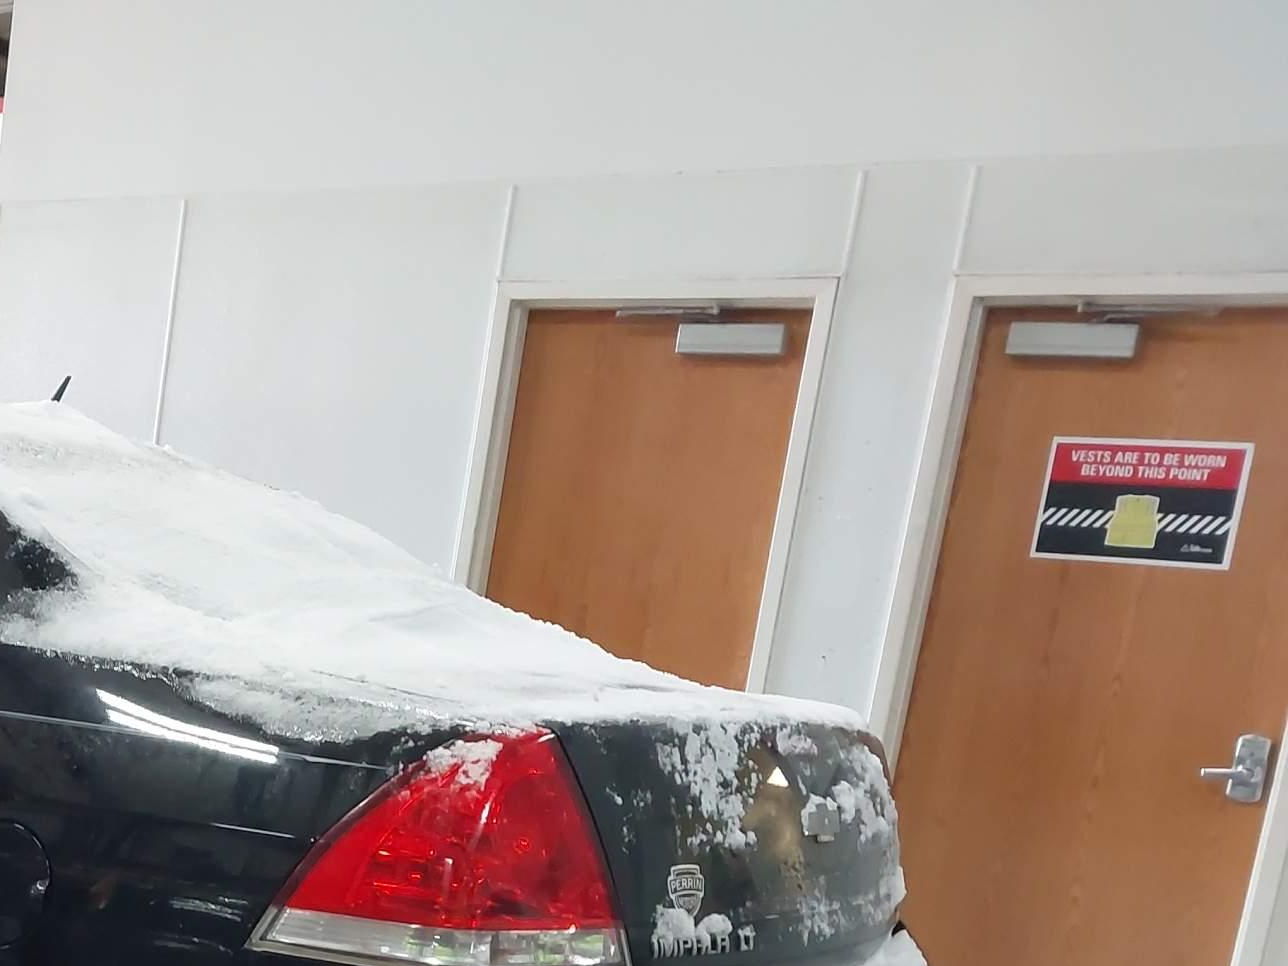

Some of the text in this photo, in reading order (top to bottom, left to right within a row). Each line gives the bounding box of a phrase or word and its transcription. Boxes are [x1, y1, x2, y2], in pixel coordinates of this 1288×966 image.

[1071, 449, 1227, 468] VESTS ARE TO BE WORN
[1081, 463, 1211, 481] BEYOND THIS POINT
[670, 877, 702, 893] PERRIN
